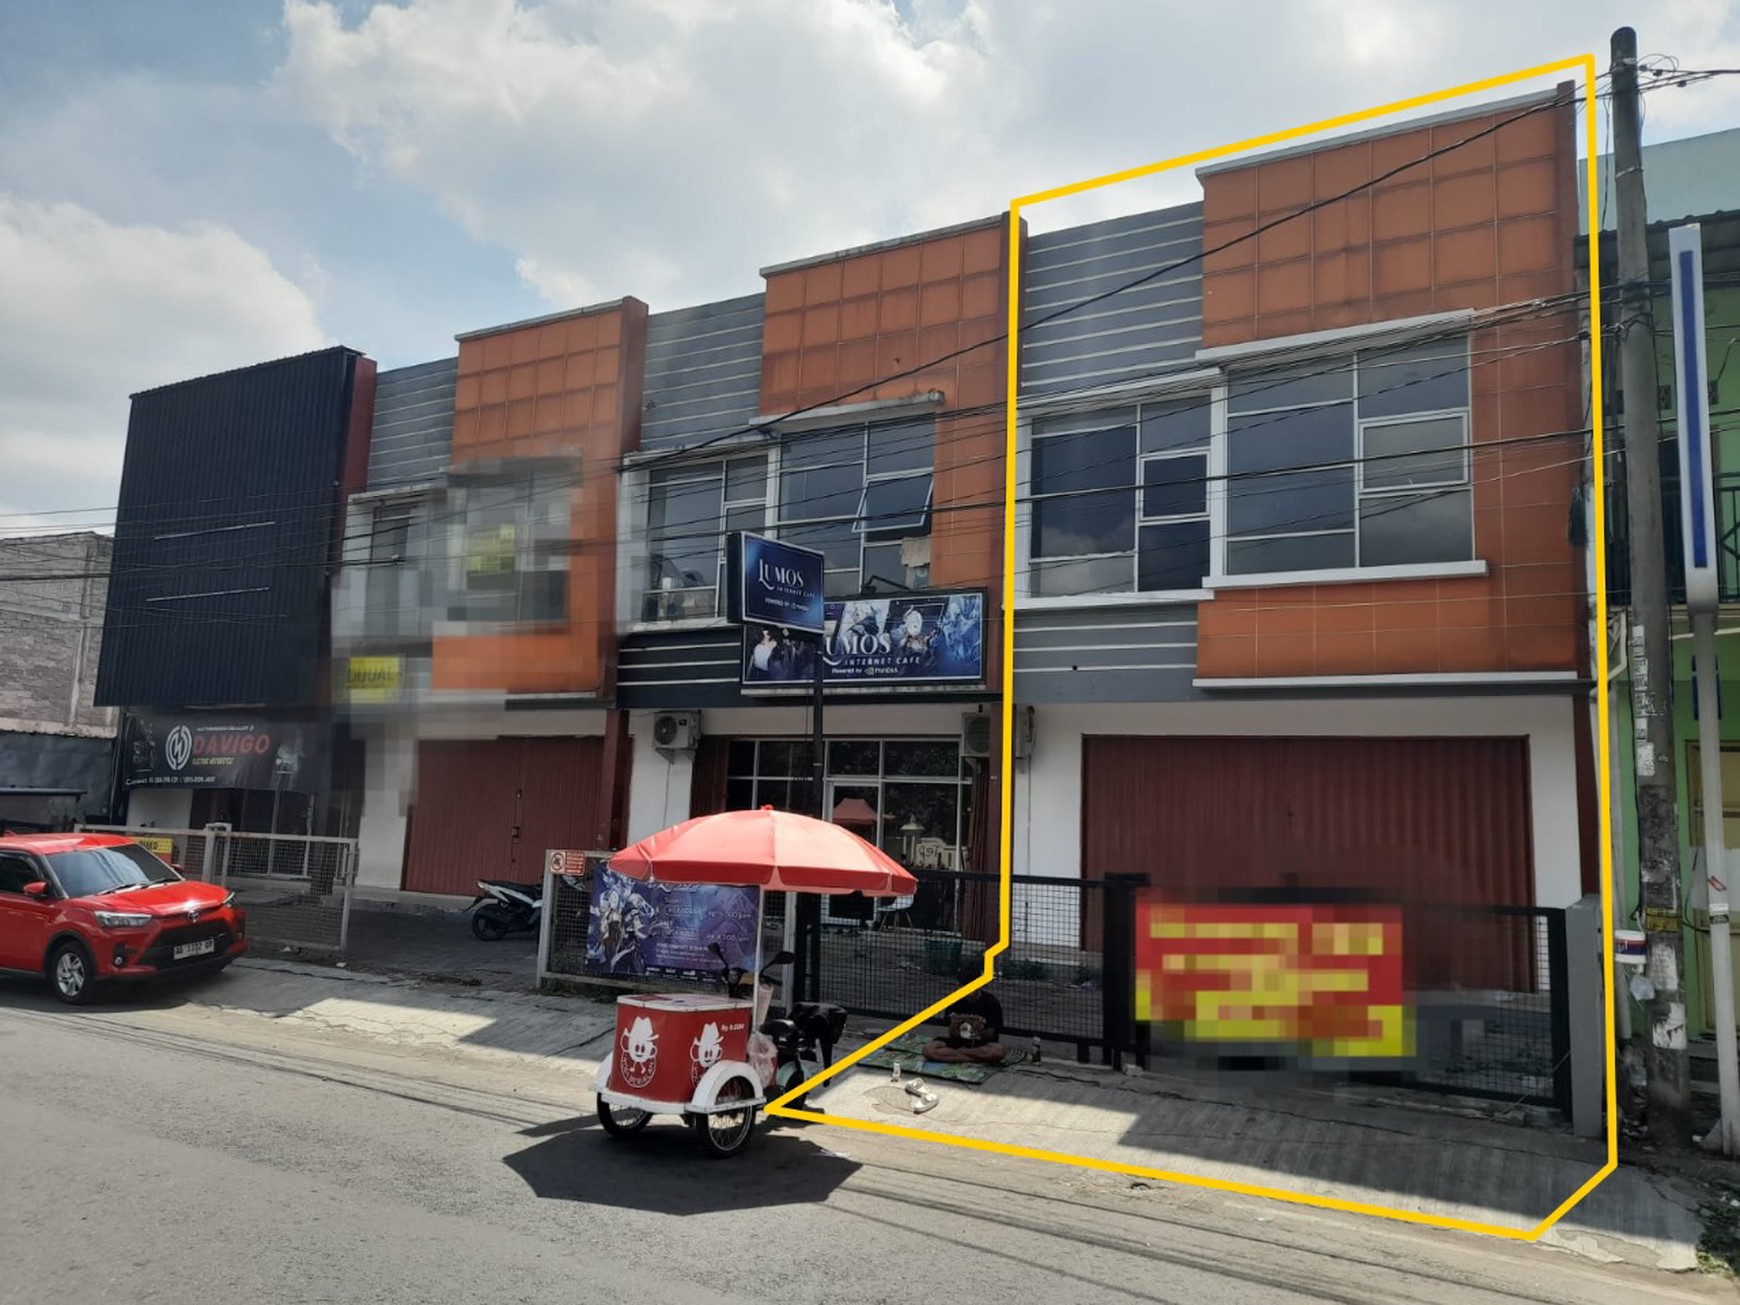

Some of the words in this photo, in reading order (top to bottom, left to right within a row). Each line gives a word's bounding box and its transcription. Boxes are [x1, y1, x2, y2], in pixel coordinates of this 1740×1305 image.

[759, 558, 804, 590] LUMOS
[844, 657, 892, 666] INTERNET
[896, 656, 920, 665] CAFE
[193, 734, 270, 755] DAVIGO
